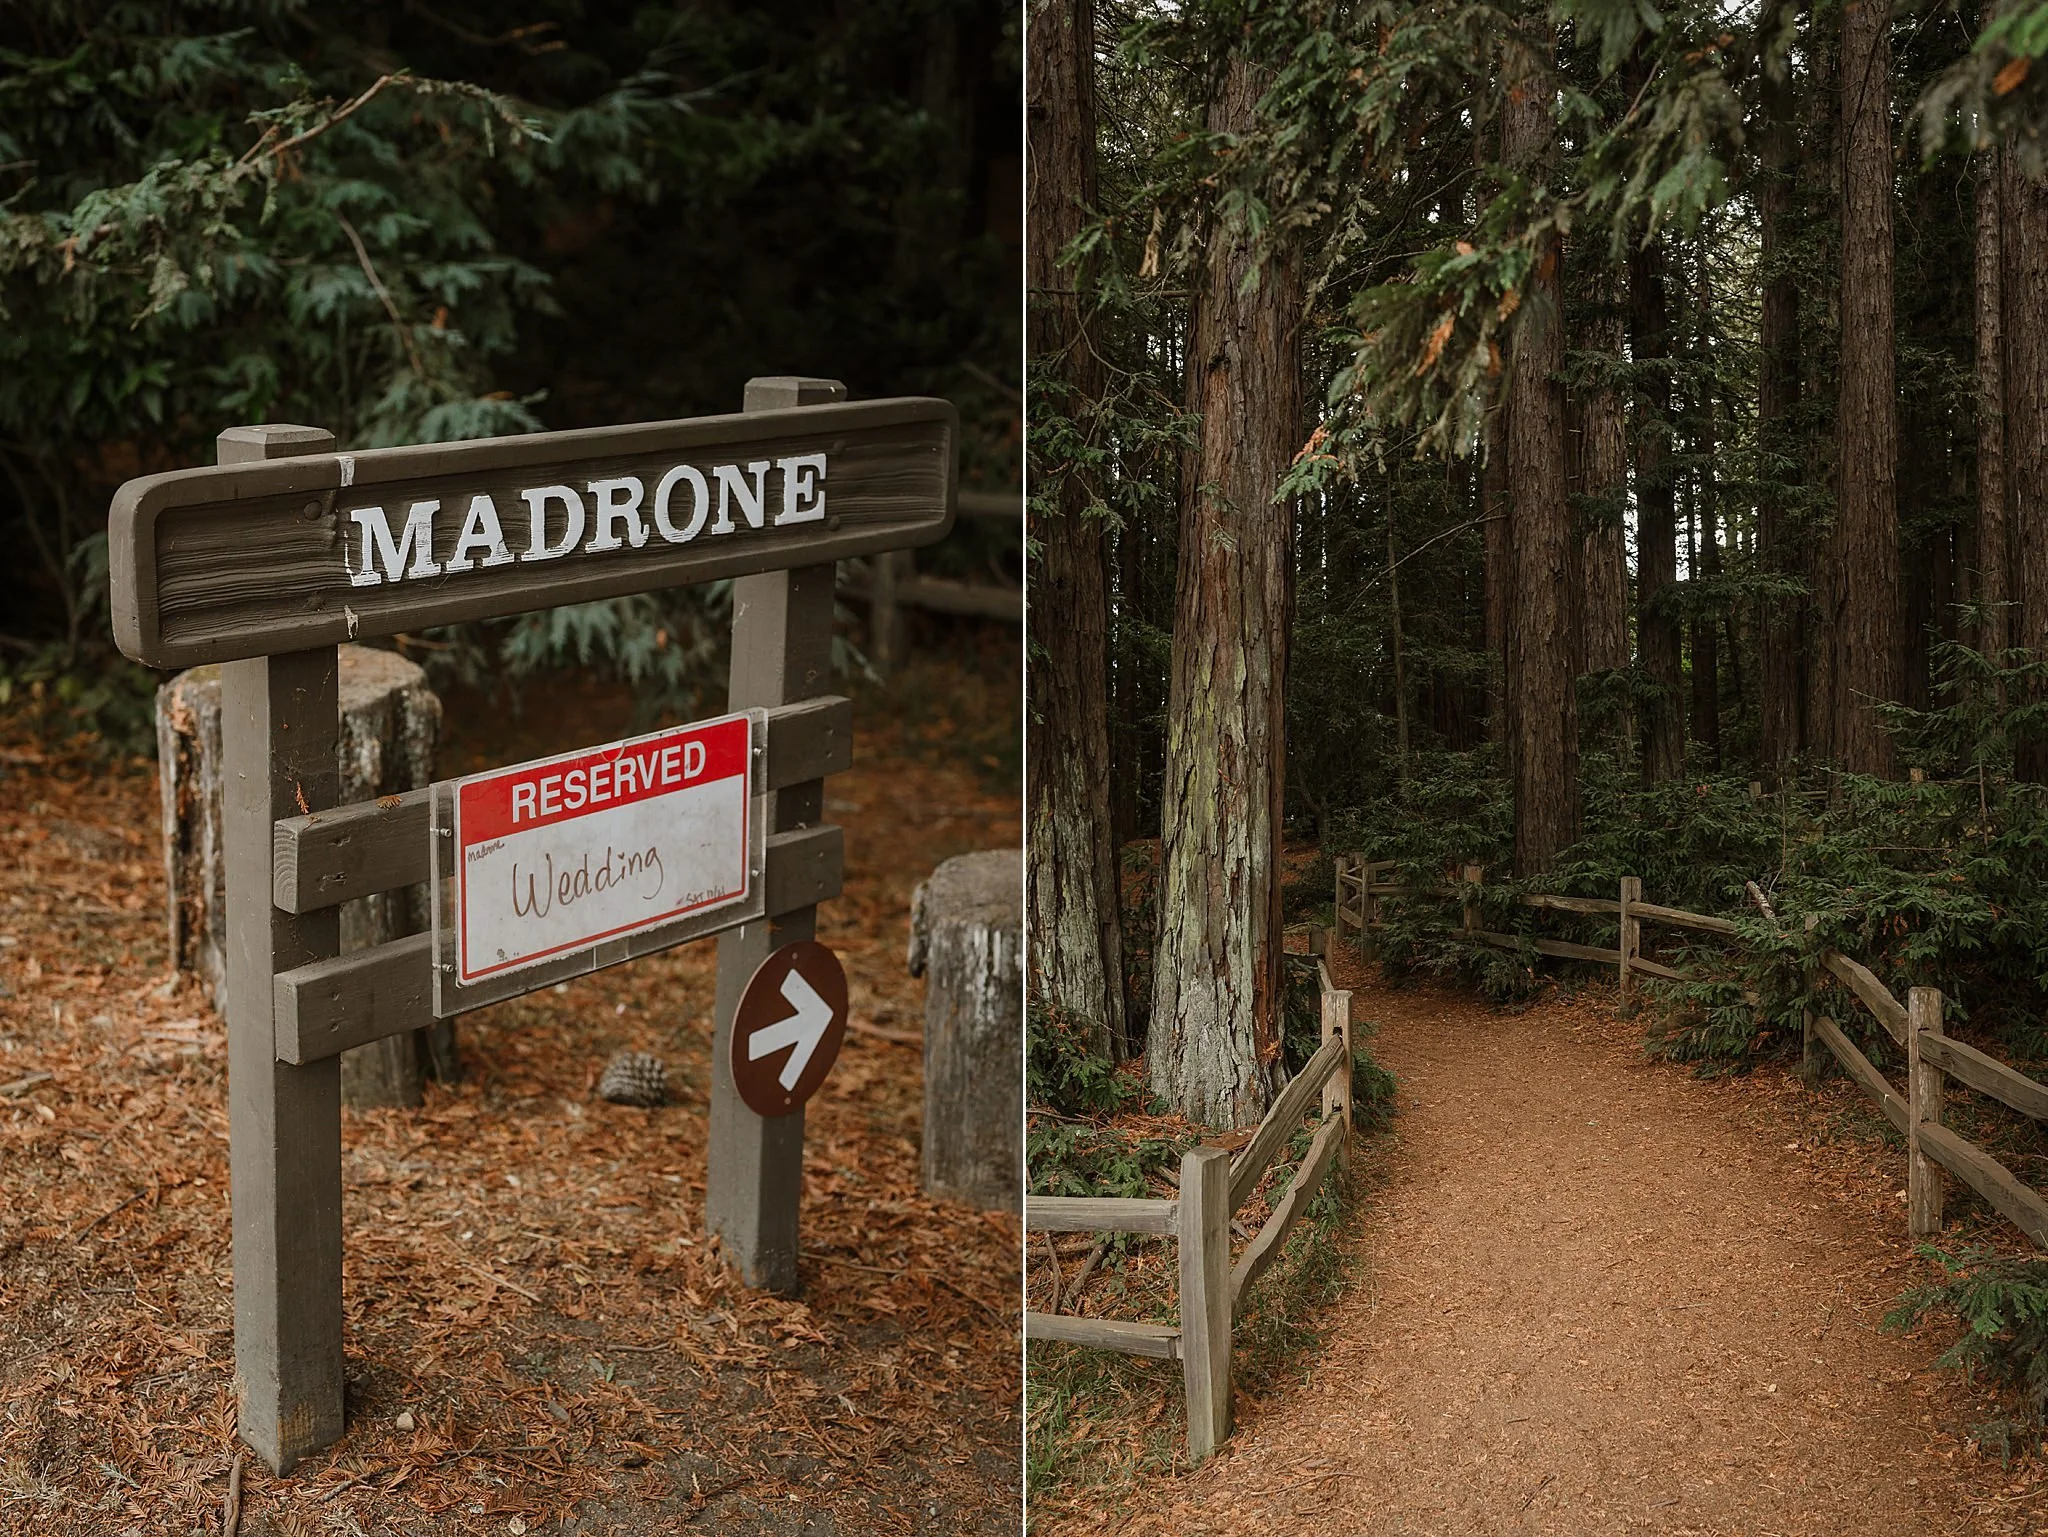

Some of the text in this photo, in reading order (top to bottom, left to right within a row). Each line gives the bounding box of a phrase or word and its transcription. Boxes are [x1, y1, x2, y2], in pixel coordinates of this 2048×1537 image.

[351, 454, 827, 585] MADRONE
[511, 740, 707, 823] RESERVED
[512, 846, 663, 919] Wedding
